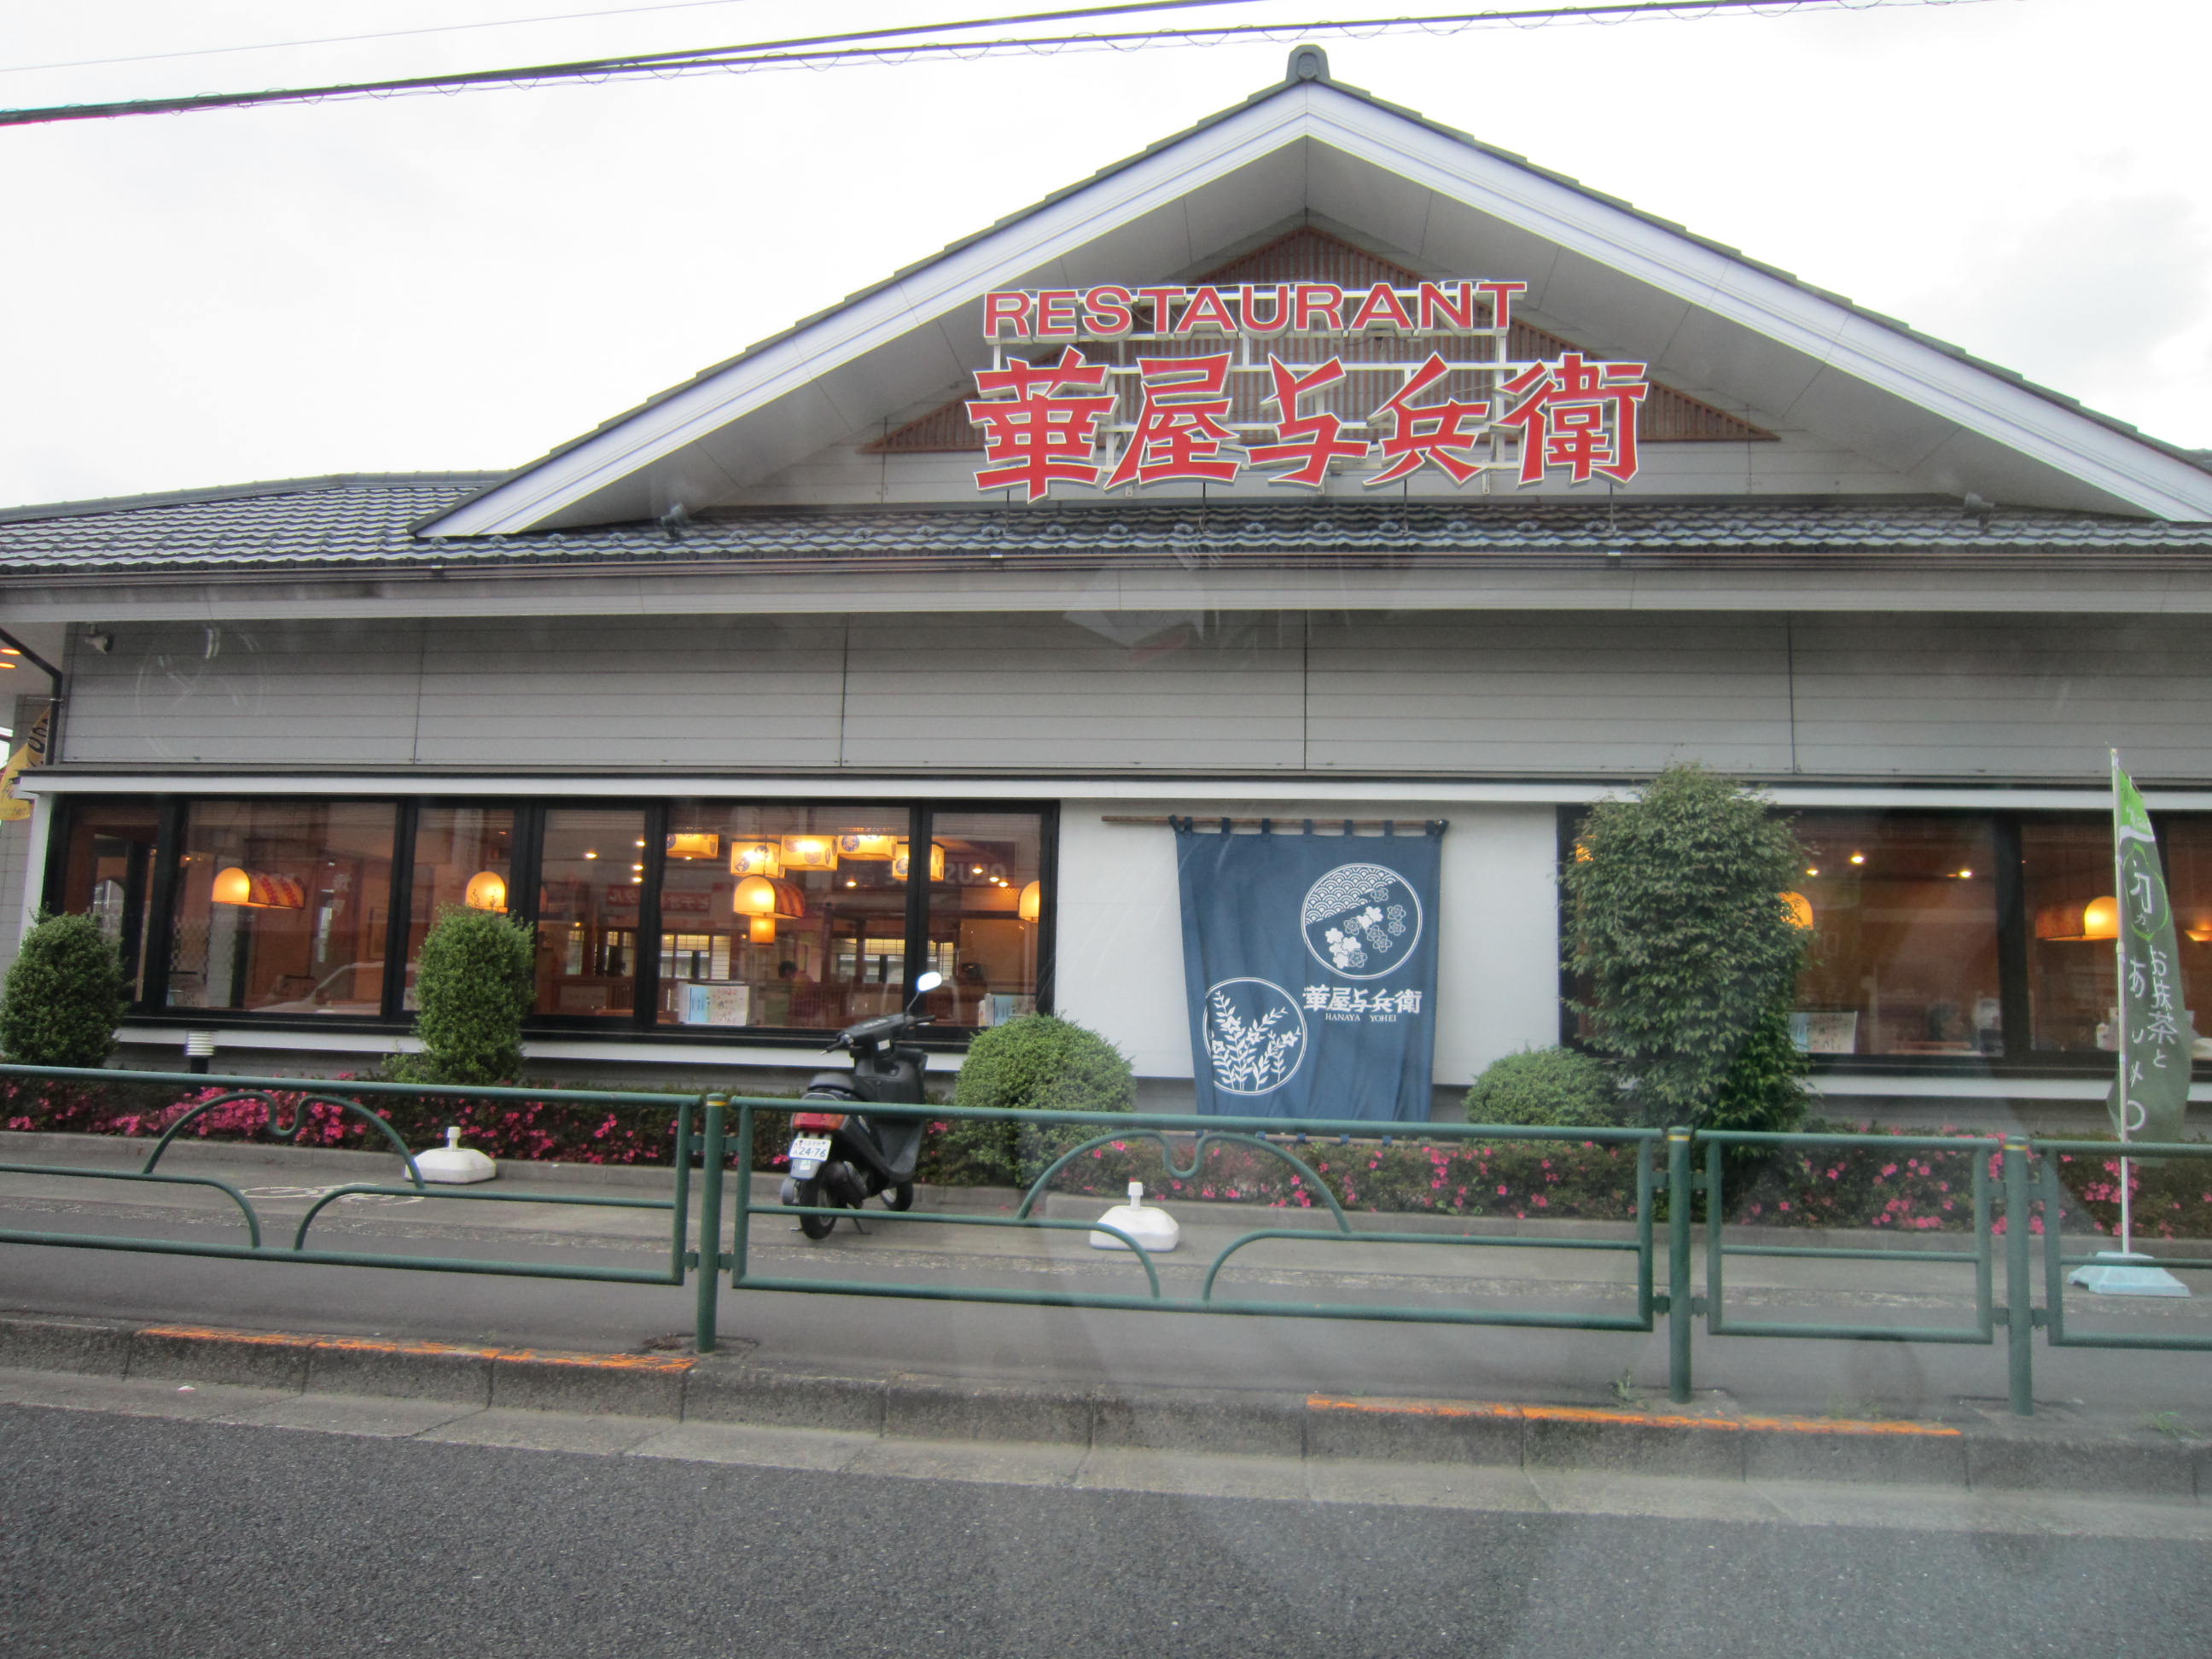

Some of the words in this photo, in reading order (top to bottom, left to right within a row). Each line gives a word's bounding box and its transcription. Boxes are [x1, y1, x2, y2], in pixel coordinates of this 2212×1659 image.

[983, 282, 1528, 341] RESTAURANT
[965, 345, 1649, 504] 華屋与兵衛
[1302, 984, 1423, 1014] 華屋与兵衛
[1325, 1013, 1360, 1022] HANAYA
[1370, 1014, 1397, 1022] YOHEI
